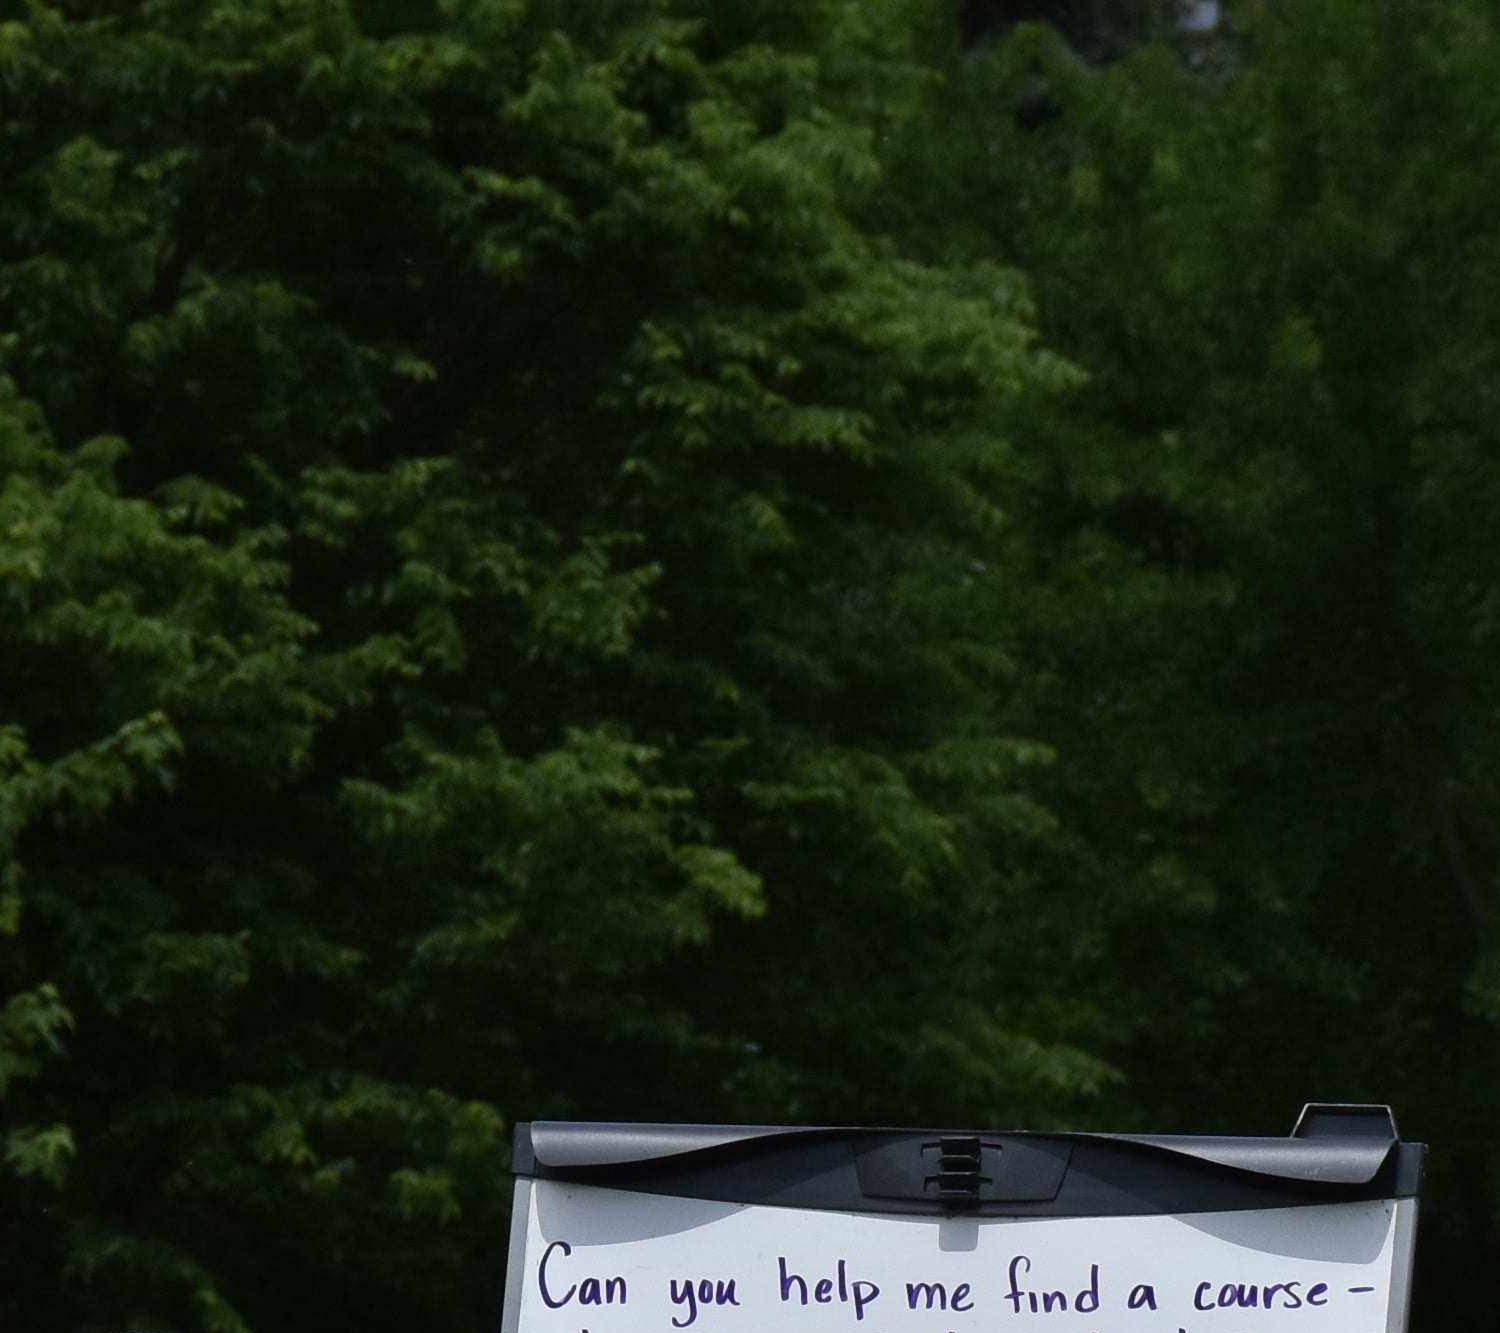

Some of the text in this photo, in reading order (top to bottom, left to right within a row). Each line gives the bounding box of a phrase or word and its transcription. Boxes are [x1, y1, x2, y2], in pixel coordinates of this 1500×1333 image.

[539, 1241, 626, 1308] Can
[671, 1279, 740, 1327] you
[779, 1257, 879, 1320] help
[906, 1283, 974, 1311] me
[1004, 1256, 1099, 1313] find
[1128, 1285, 1157, 1310] a
